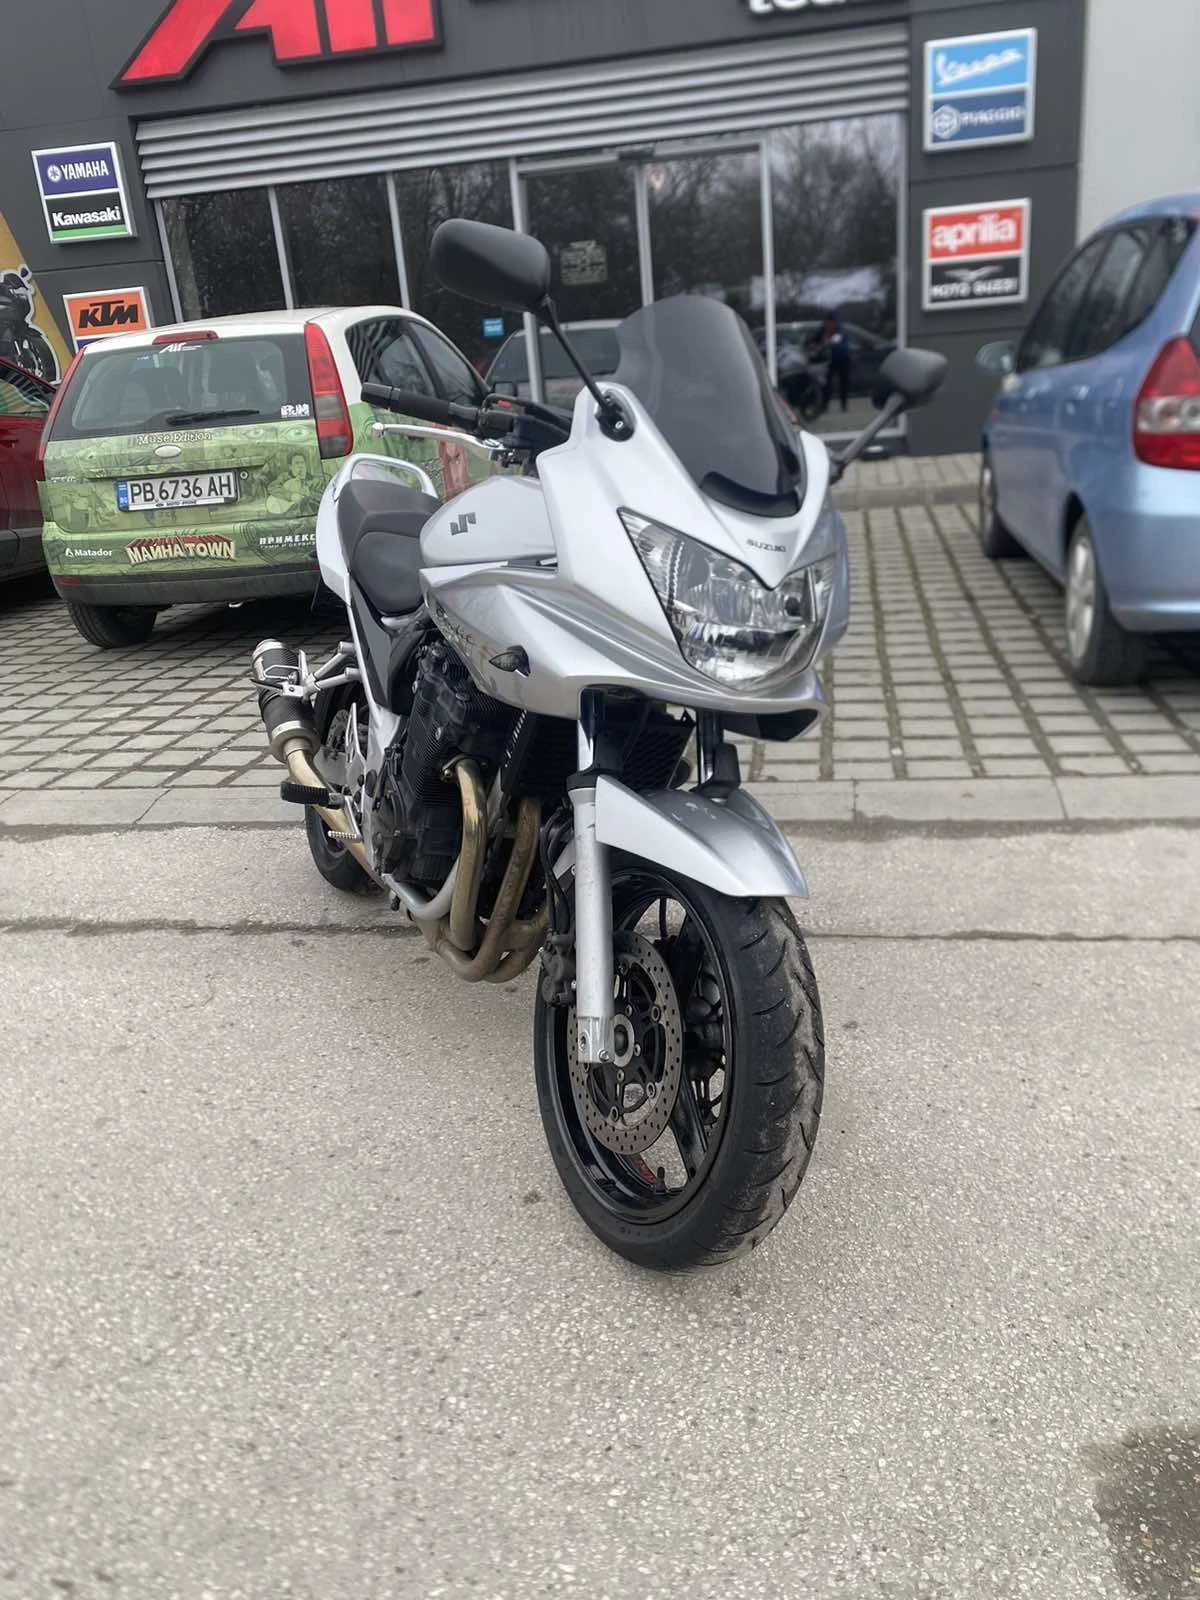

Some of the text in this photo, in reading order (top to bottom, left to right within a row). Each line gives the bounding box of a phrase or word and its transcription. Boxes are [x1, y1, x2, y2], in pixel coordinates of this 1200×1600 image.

[61, 159, 110, 180] YAMAHA
[52, 206, 121, 227] Kawasaki
[932, 211, 1017, 253] aprilia
[78, 299, 139, 329] KTM
[137, 431, 213, 446] Muse Edition
[130, 482, 155, 503] PB
[159, 477, 203, 500] 6736
[207, 471, 232, 497] AH
[74, 547, 113, 557] Matador
[184, 538, 235, 560] TOWN
[747, 538, 787, 553] SUZUKI
